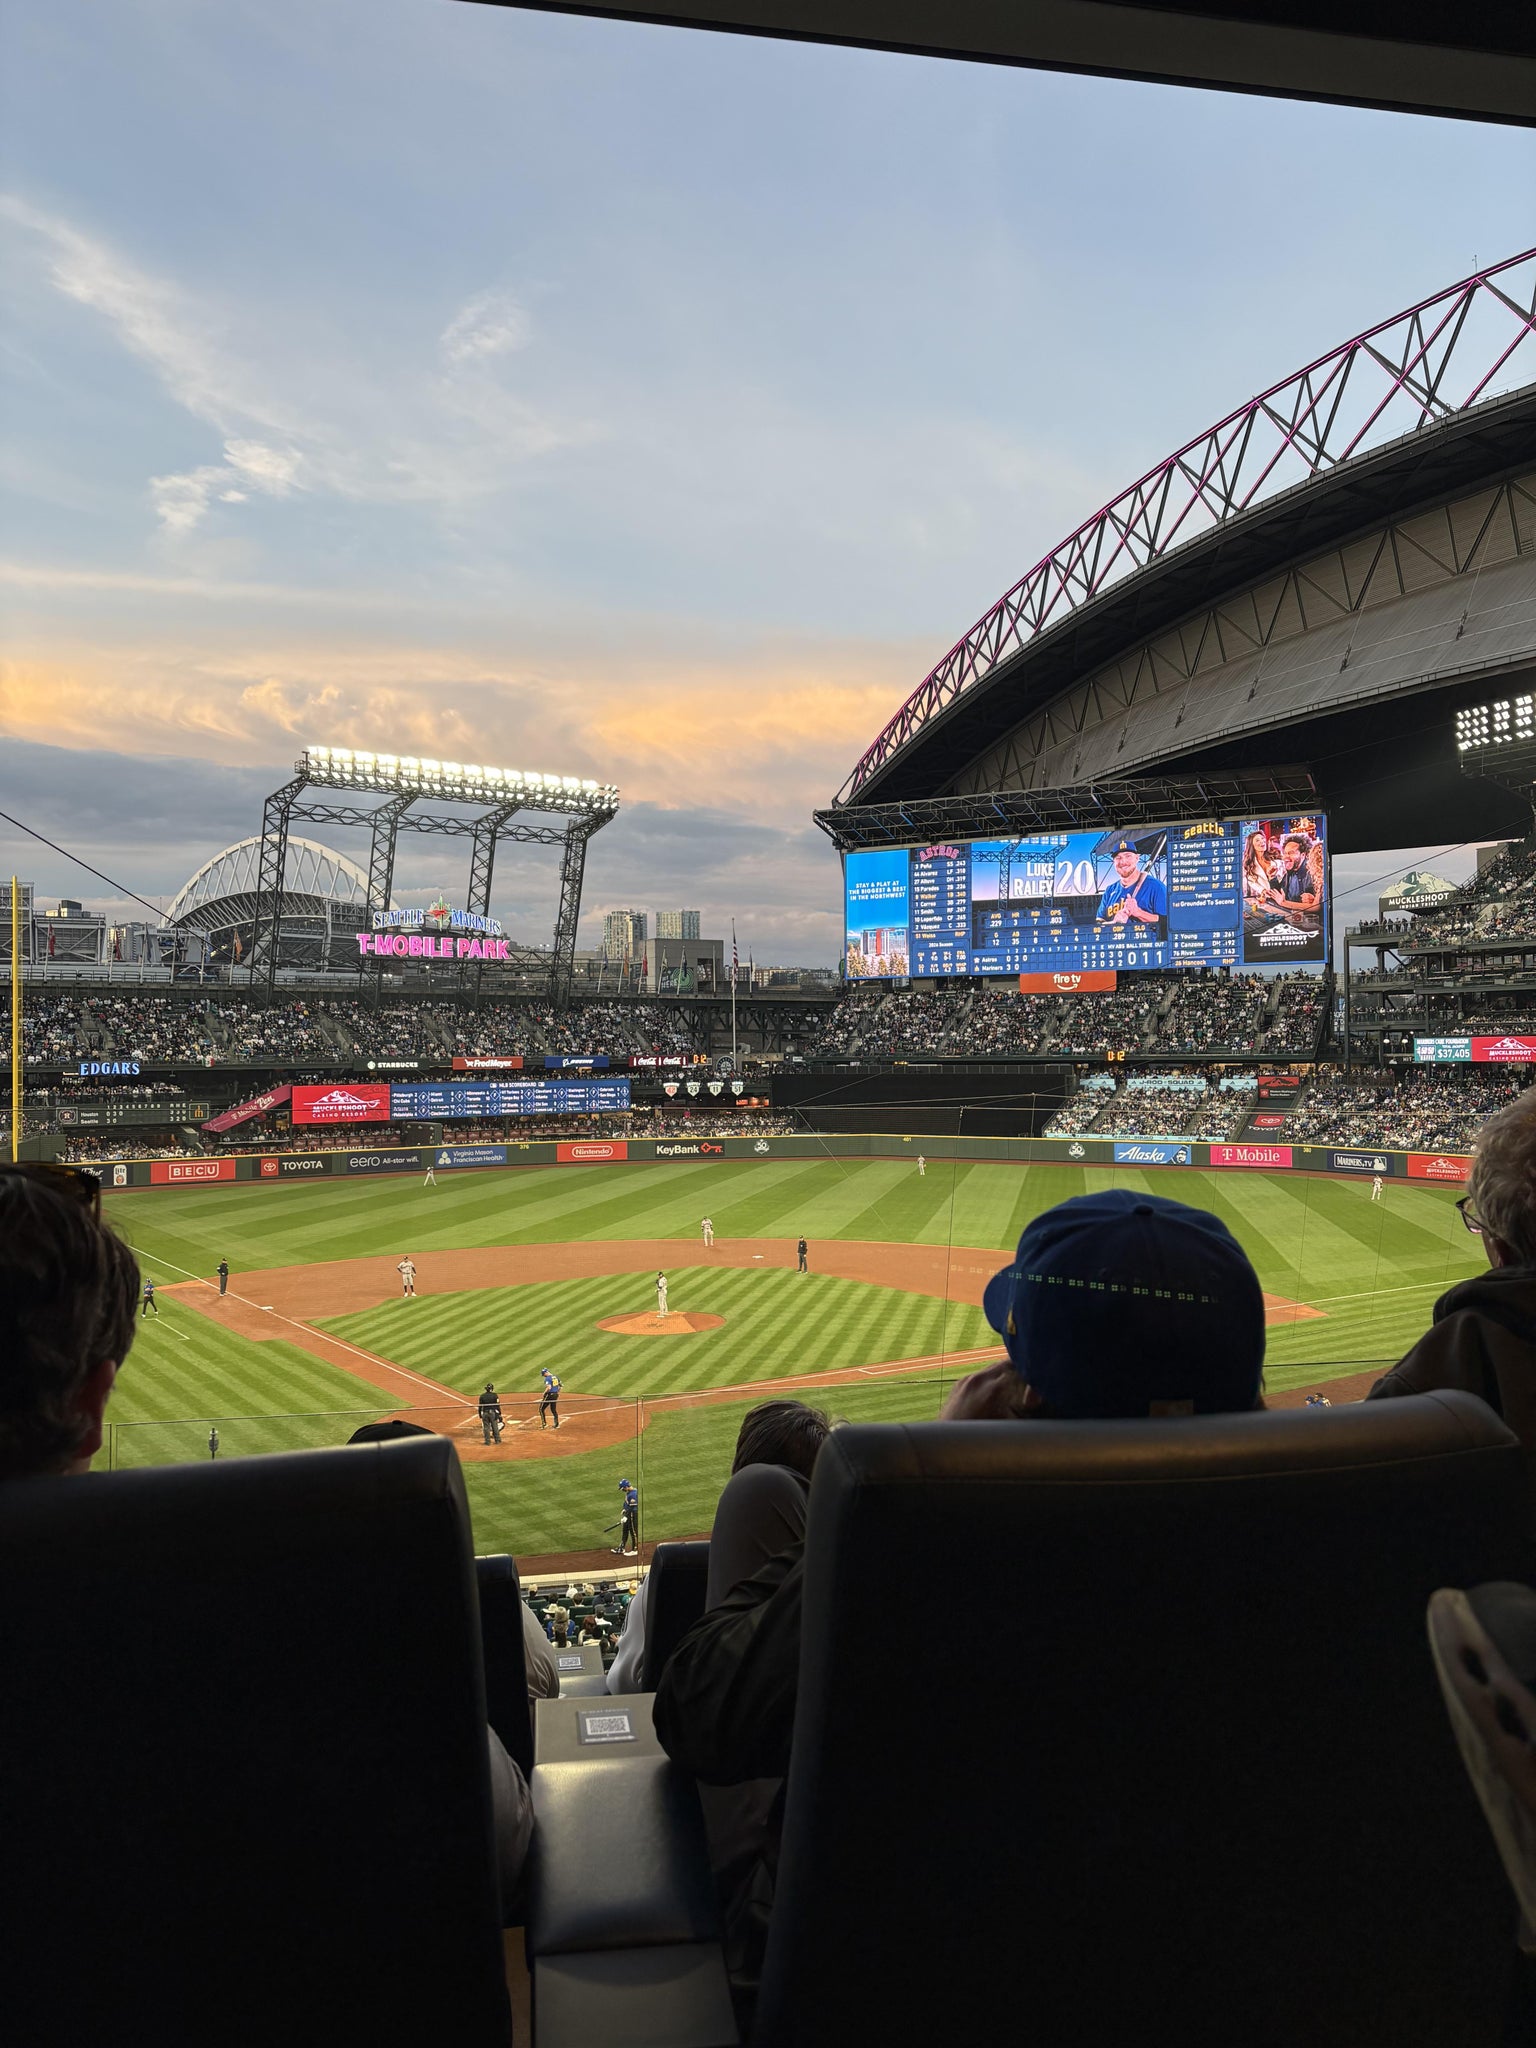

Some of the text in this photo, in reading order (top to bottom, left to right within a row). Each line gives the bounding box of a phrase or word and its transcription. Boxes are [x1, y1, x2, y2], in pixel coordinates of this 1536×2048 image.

[1184, 822, 1224, 840] seattle
[920, 845, 959, 861] ASTROS
[1026, 862, 1054, 877] LUKE
[1056, 861, 1094, 894] 20
[1014, 878, 1053, 897] RALEY
[1389, 893, 1449, 906] MUCKLESHOOT
[373, 908, 502, 936] SEATTLE MARINERS
[356, 933, 511, 959] T-MOBILE PARK
[1128, 951, 1161, 964] 0 1 1
[1053, 974, 1081, 983] fire tv
[1108, 1051, 1125, 1061] 0:12
[1438, 1049, 1470, 1058] $37,405
[312, 1104, 366, 1113] MUCKLESHOOT
[575, 1147, 611, 1155] Nintendo
[656, 1145, 700, 1156] KeyBank
[1072, 1145, 1082, 1153] 50
[1118, 1146, 1165, 1161] Alaska
[1236, 1148, 1280, 1162] Mobile
[282, 1161, 323, 1170] TOYOTA
[350, 1156, 380, 1168] eero
